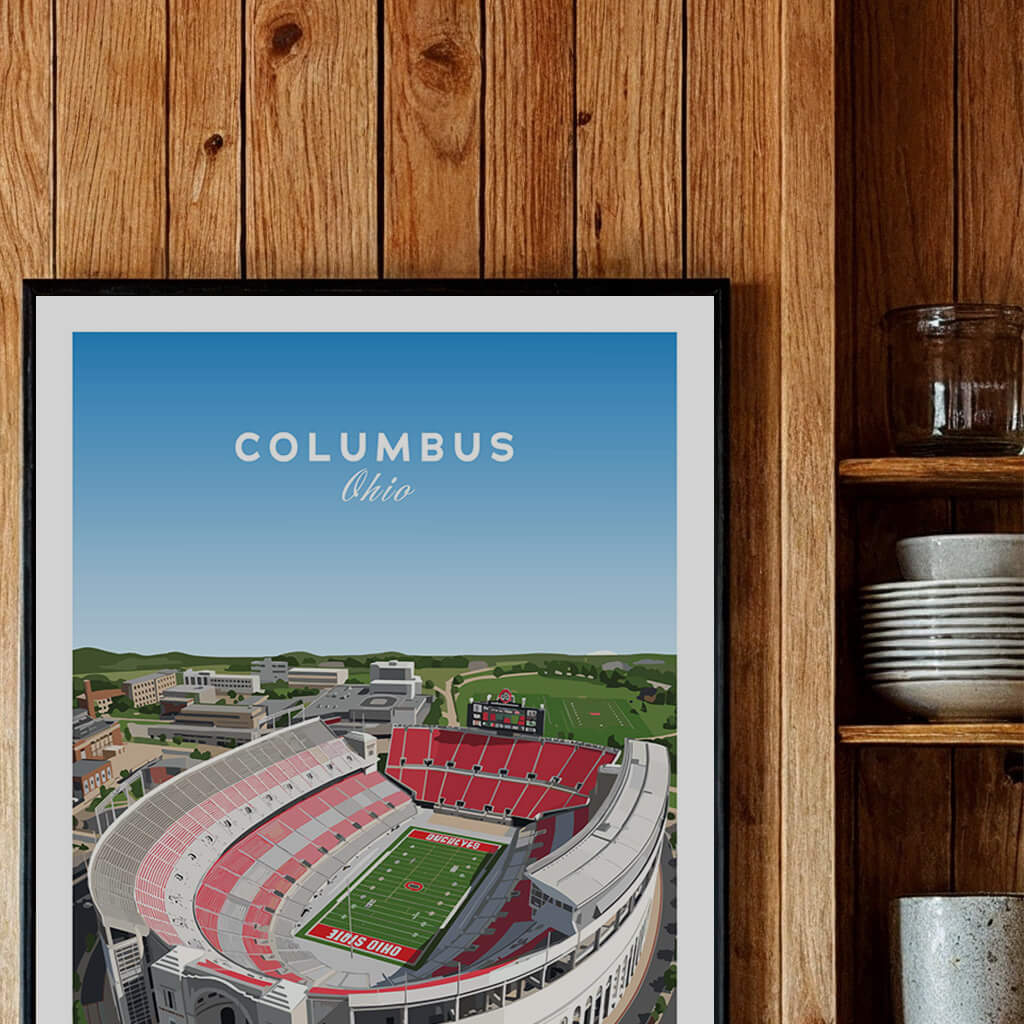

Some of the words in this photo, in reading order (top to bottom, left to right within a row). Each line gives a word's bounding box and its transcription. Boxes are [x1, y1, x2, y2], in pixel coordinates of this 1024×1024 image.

[235, 431, 514, 462] COLUMBUS
[340, 467, 416, 503] Ohio
[366, 940, 402, 957] OHIO
